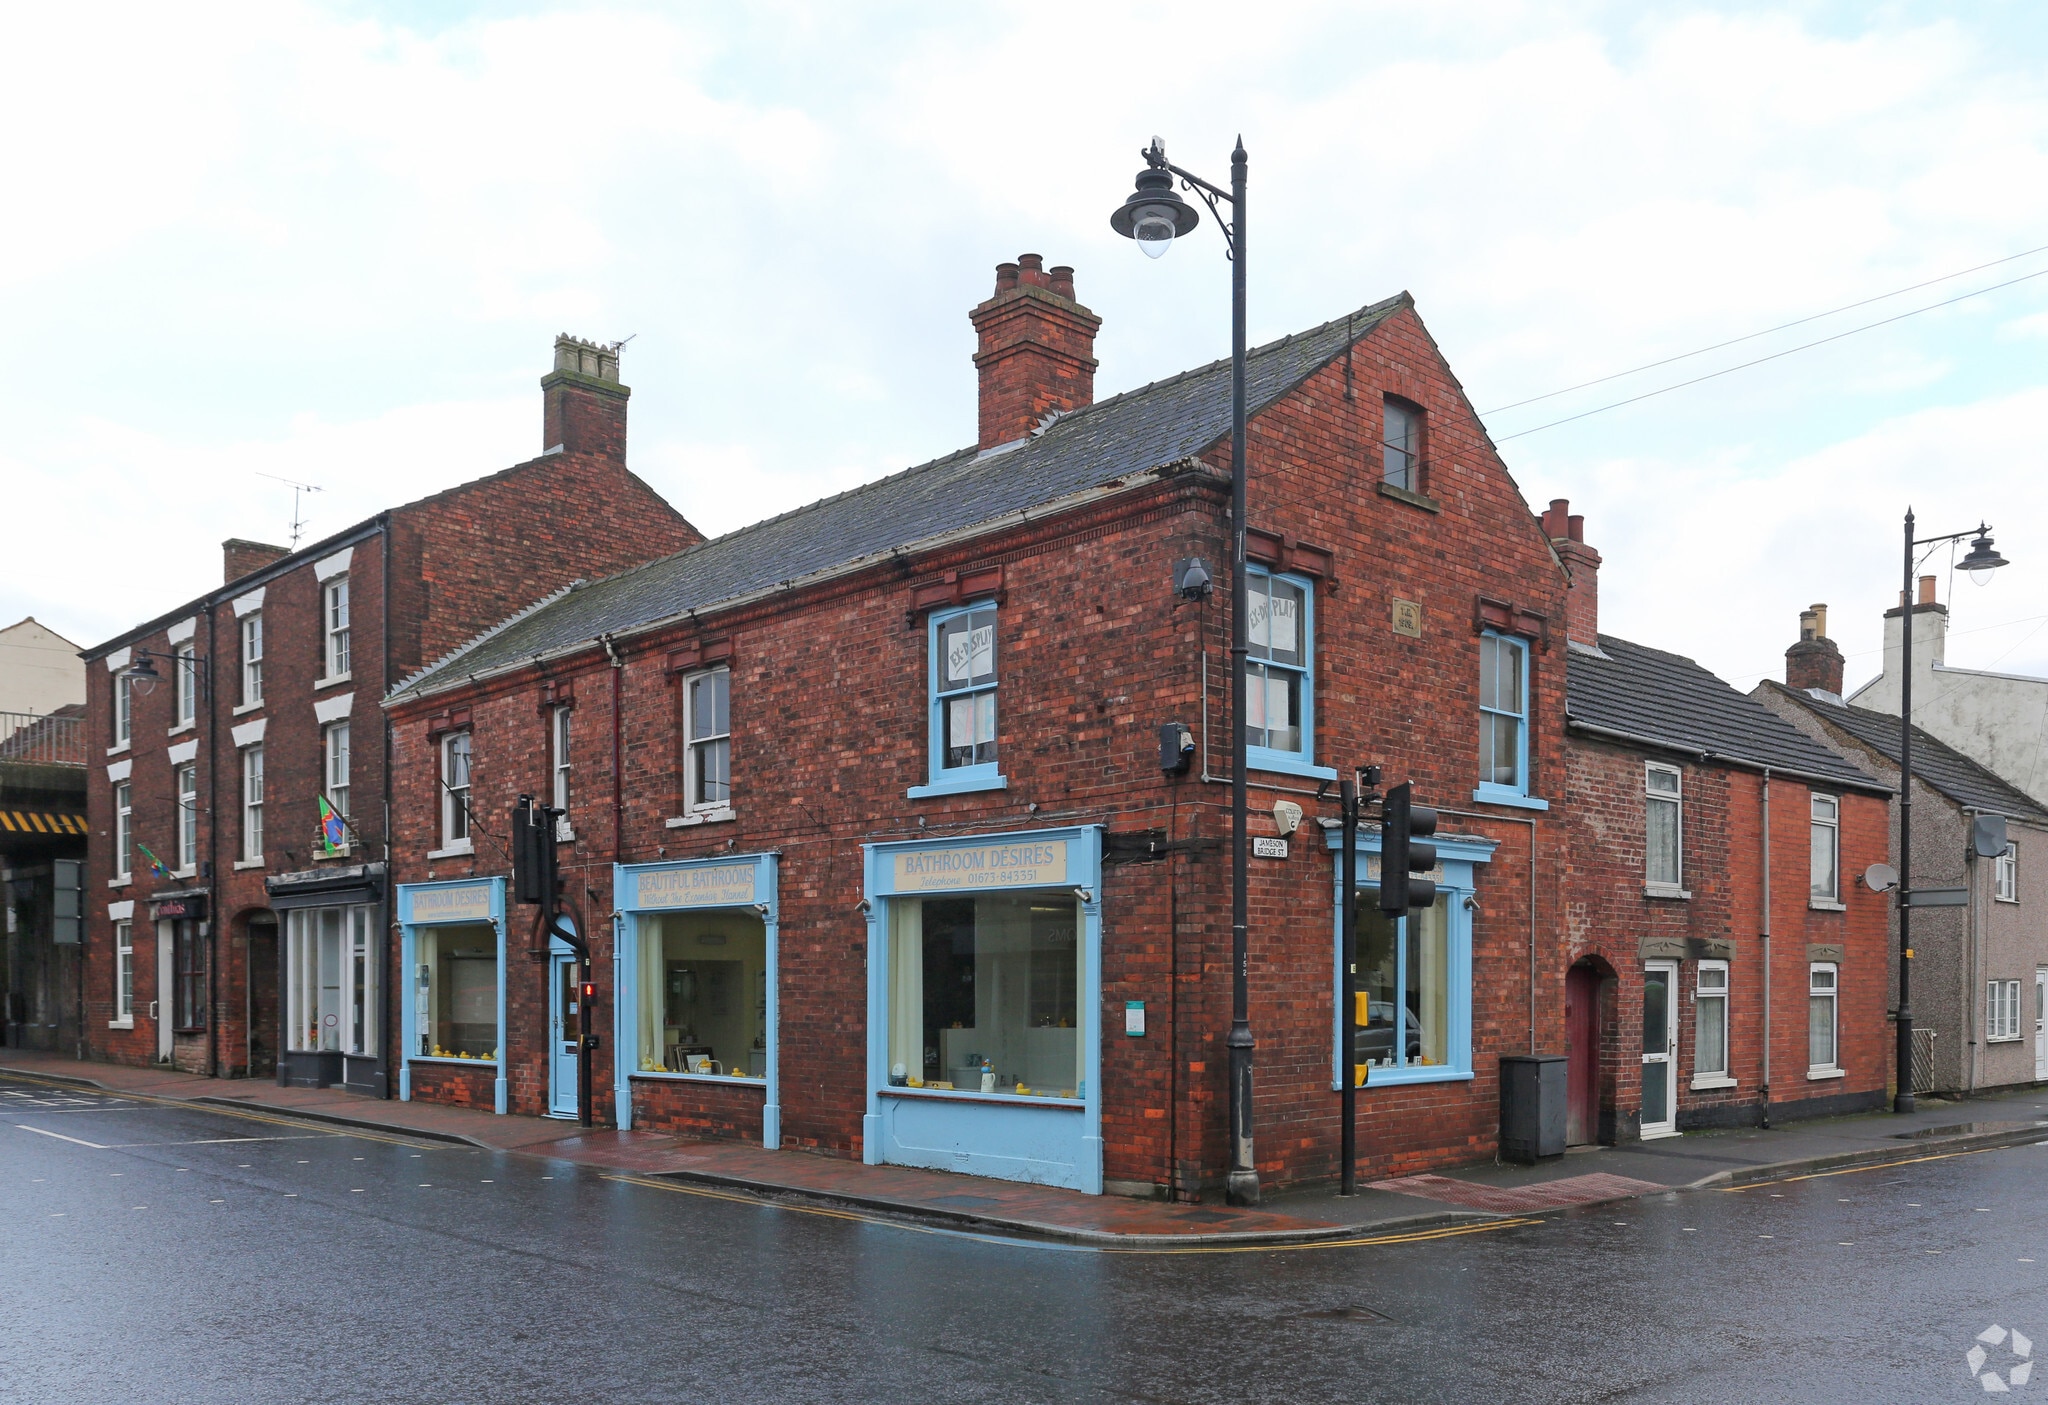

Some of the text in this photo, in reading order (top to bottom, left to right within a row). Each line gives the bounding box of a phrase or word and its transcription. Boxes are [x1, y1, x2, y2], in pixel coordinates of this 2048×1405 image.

[949, 628, 993, 668] EX-DSPLAY
[1257, 847, 1284, 856] BRIDGE ST
[1259, 839, 1284, 848] JAMESON
[906, 845, 1054, 873] BATHROOM DESIRES
[640, 867, 753, 891] BEAUTIFUL BATHROOMS
[920, 869, 1037, 888] Telephone 01673-843351
[414, 889, 488, 909] BATHROOM DESIRES
[644, 892, 669, 905] Without
